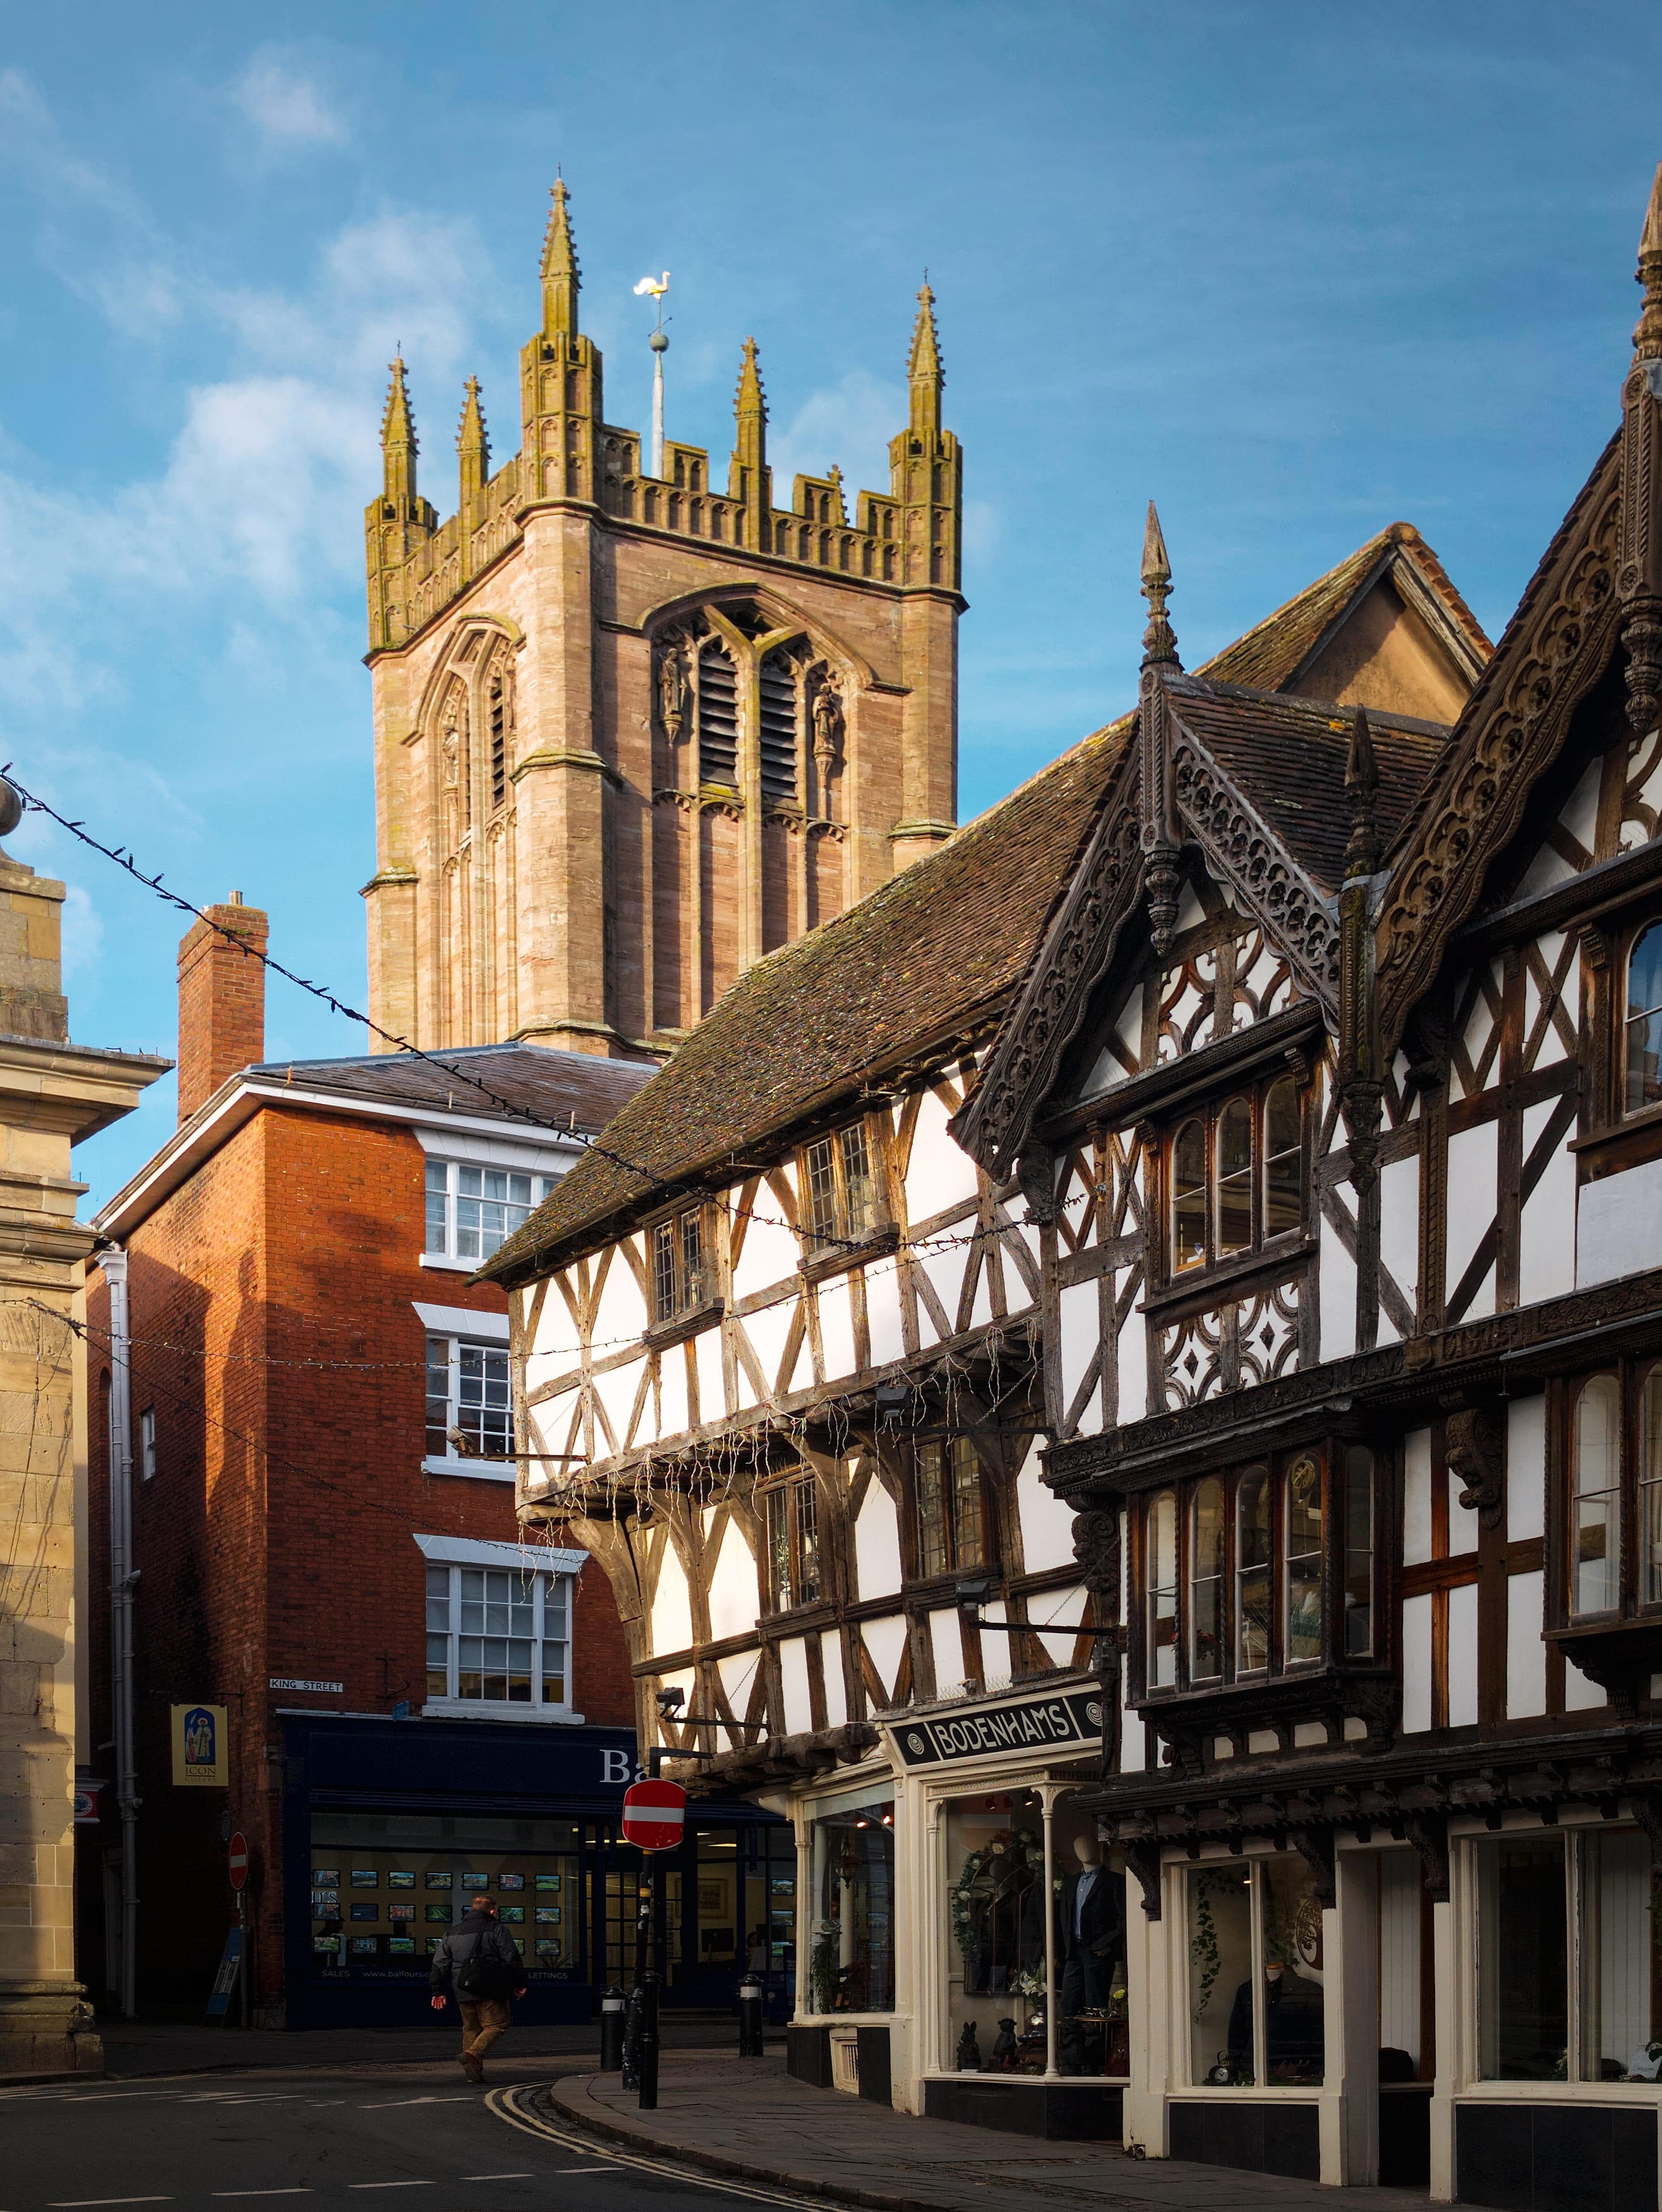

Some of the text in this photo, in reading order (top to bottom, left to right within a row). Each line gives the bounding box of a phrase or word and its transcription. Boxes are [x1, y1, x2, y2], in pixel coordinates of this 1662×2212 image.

[272, 1680, 341, 1691] KING STREET
[934, 1704, 1070, 1754] BODENHAMS
[322, 1970, 350, 1978] SALES
